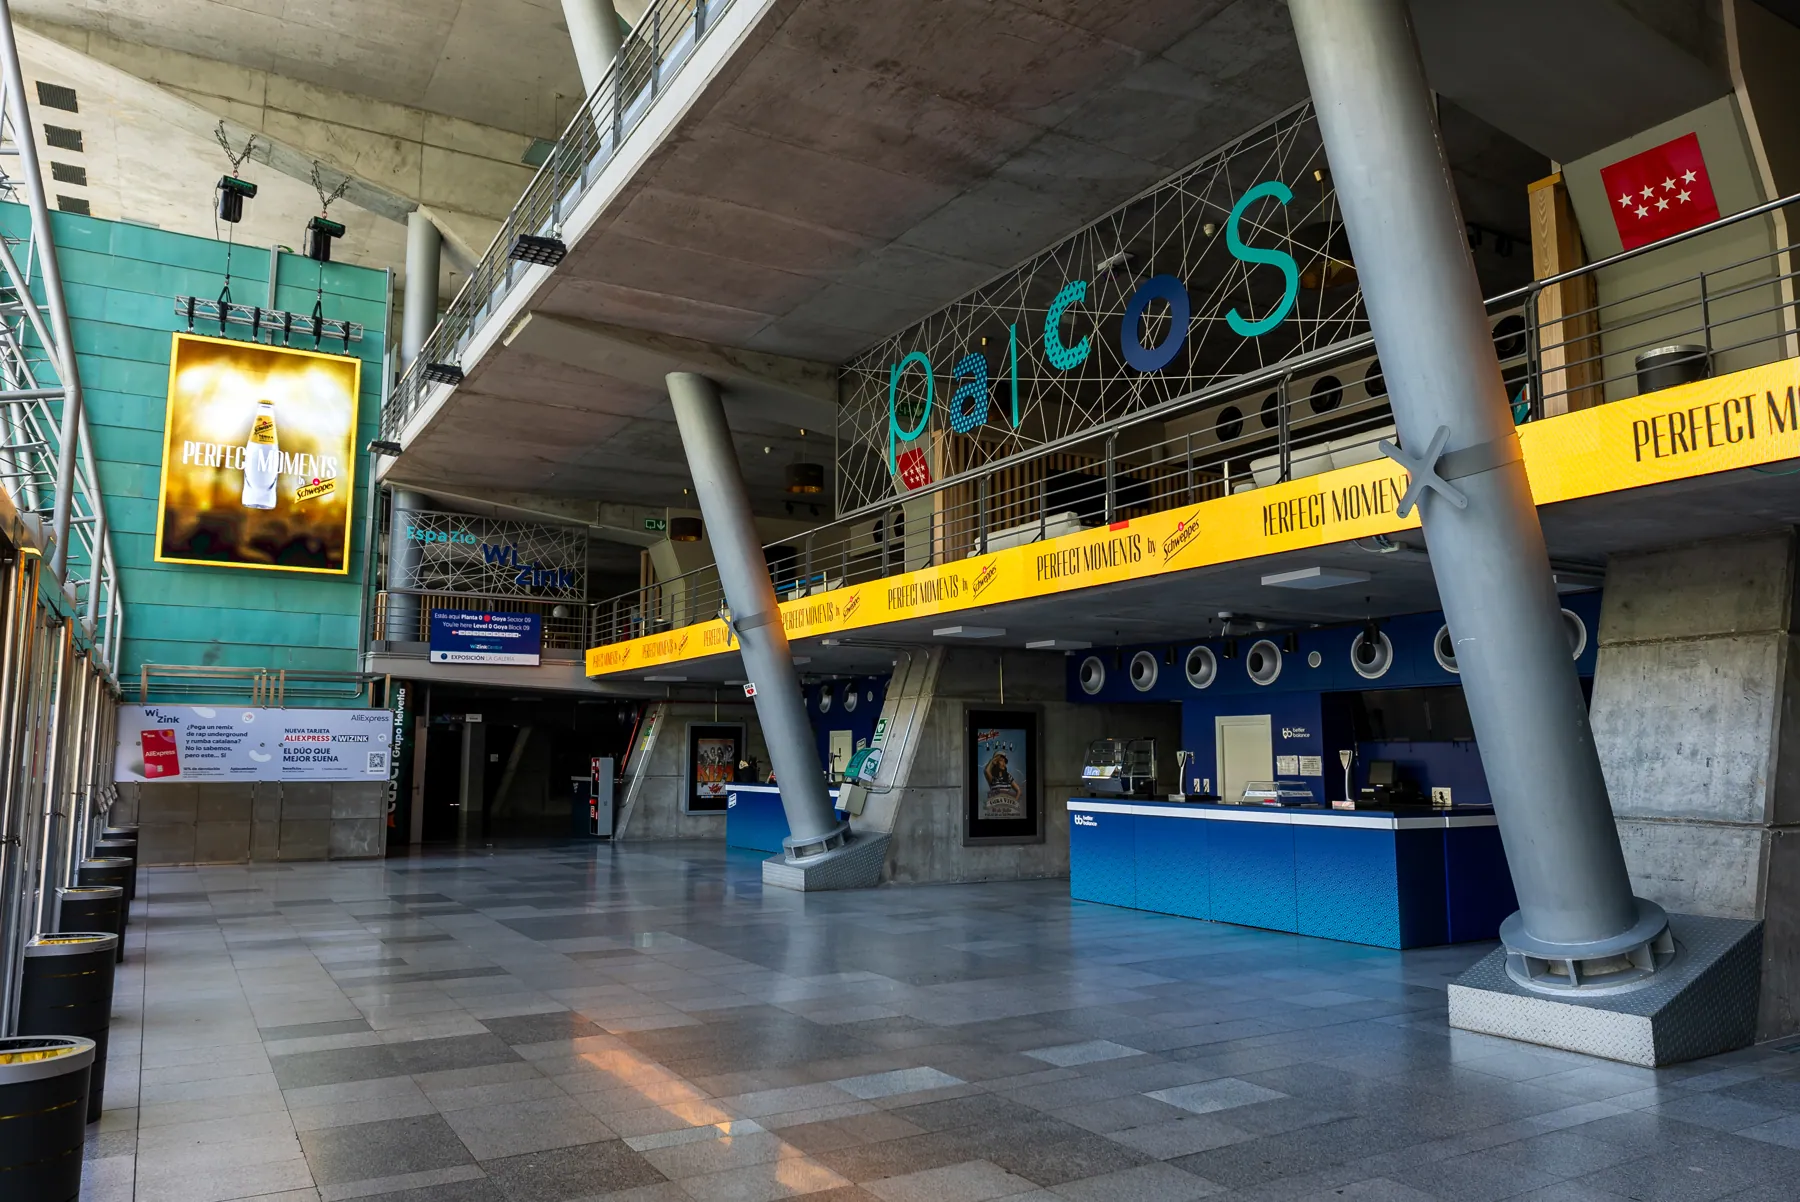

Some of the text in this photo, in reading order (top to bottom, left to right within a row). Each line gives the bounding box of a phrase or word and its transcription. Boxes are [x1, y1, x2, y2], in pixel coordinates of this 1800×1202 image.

[1633, 385, 1800, 462] PERFECT M
[182, 440, 337, 478] PERFEC MOMENTS
[296, 481, 335, 501] Schweppes
[1036, 518, 1200, 582] PERFECT MOMENTS by Schweppes
[887, 583, 918, 610] PERFECT
[919, 575, 959, 604] MOMENTS
[972, 563, 998, 596] Schweppes
[805, 602, 834, 628] MOMENTS
[157, 715, 180, 724] Zink
[351, 714, 389, 723] AliExpress
[394, 688, 406, 726] Helvetia
[392, 728, 404, 758] Grupo
